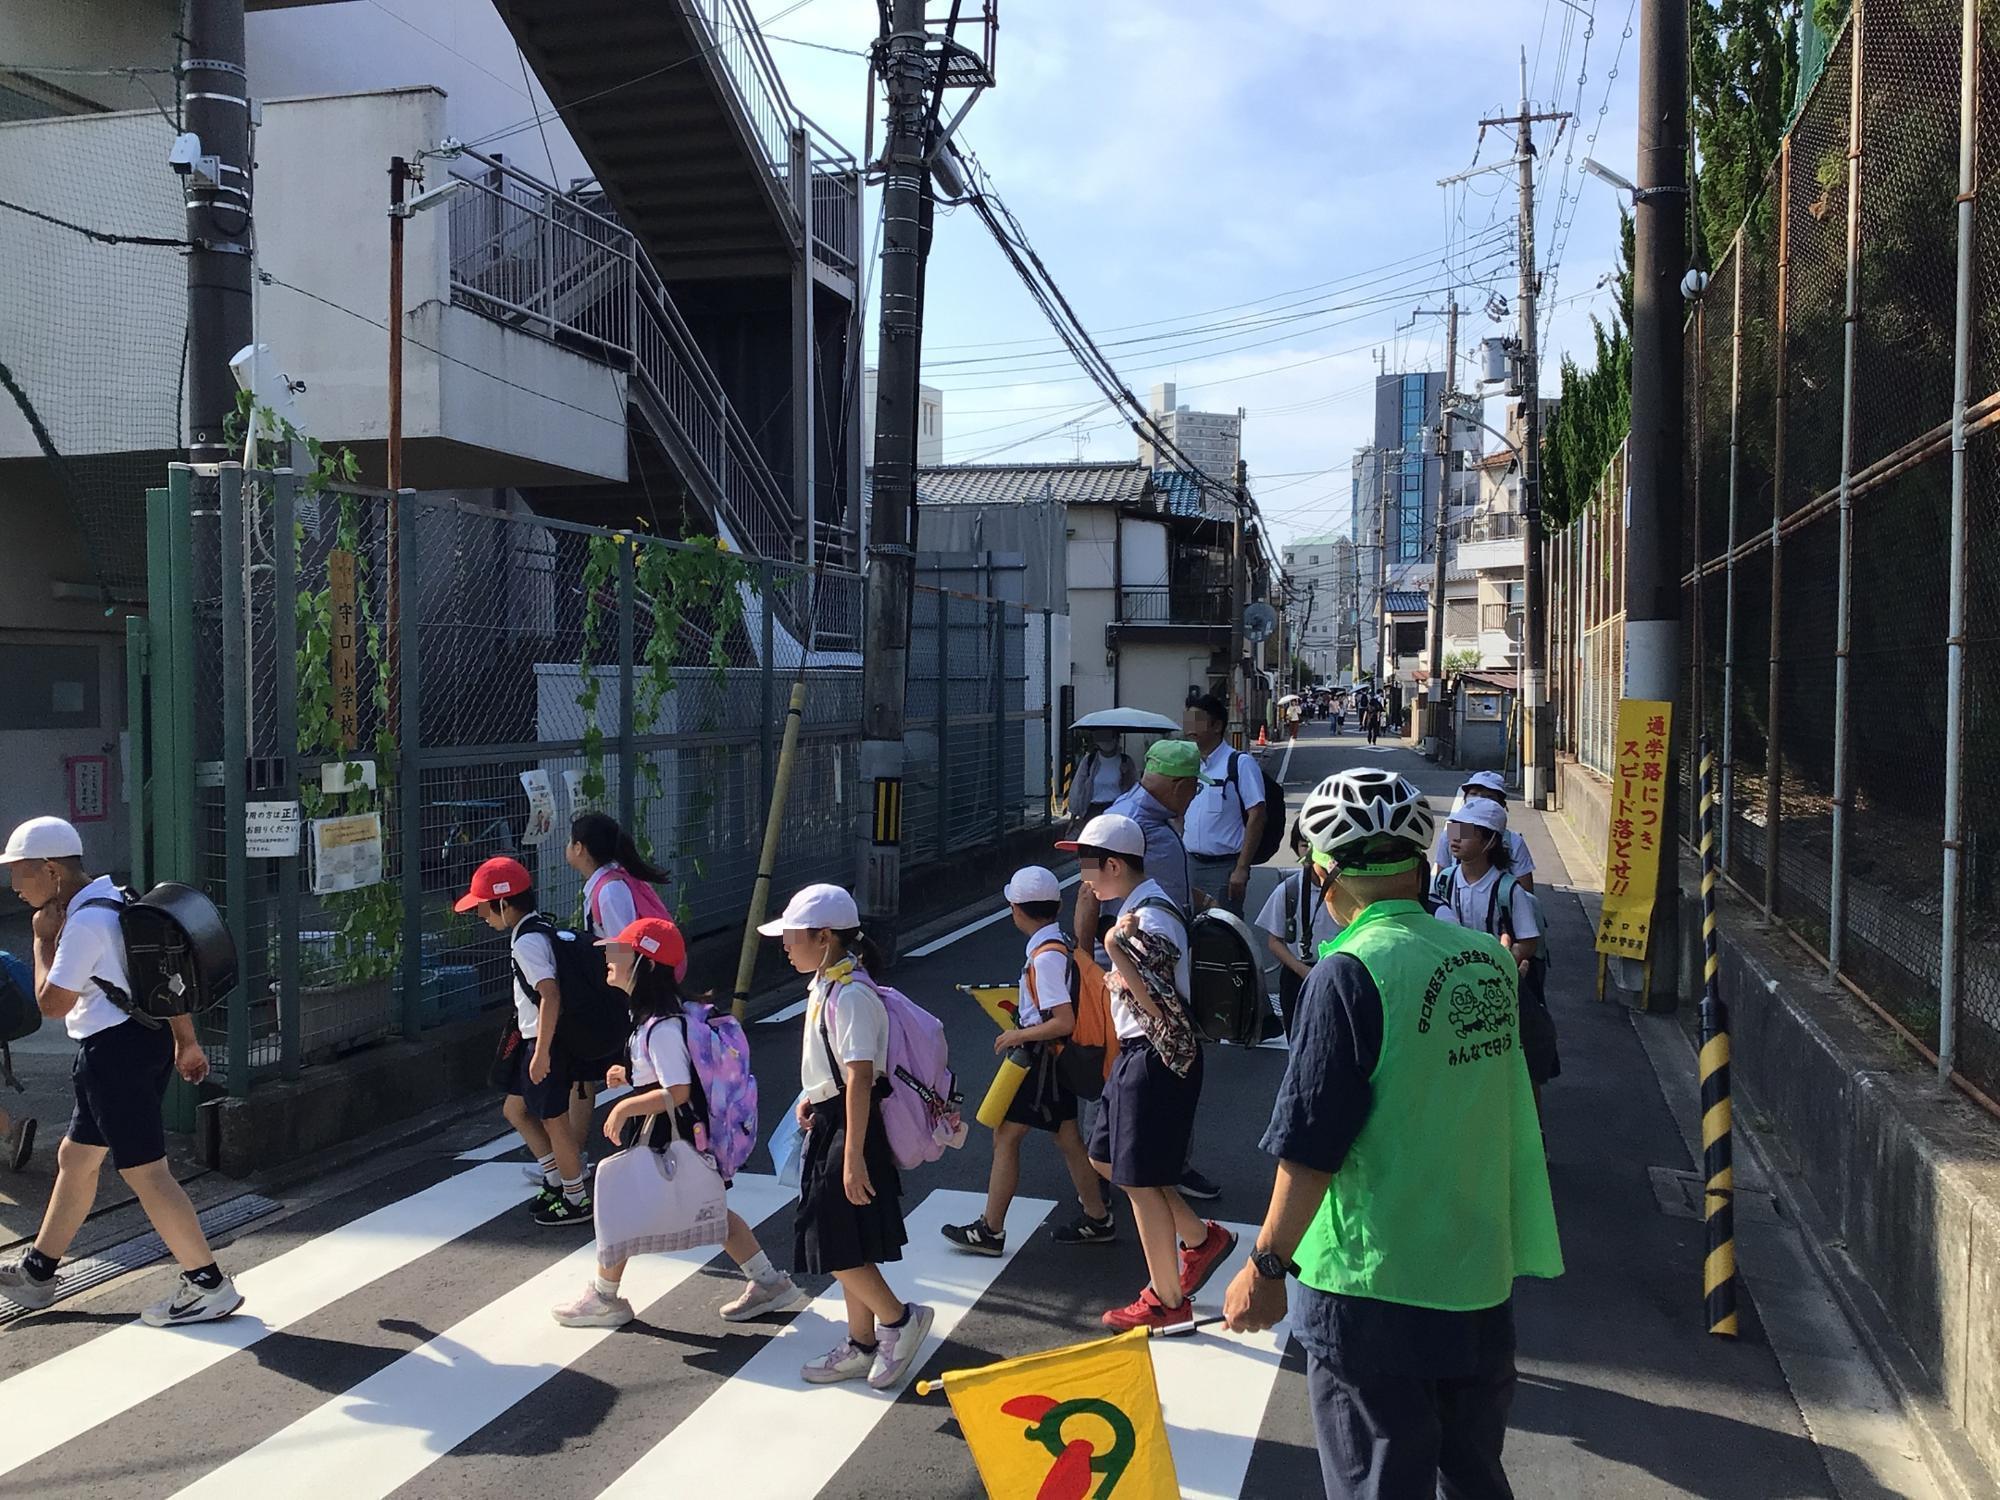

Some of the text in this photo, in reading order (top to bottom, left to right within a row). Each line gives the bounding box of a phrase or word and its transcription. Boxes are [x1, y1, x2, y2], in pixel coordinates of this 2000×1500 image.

[339, 602, 355, 736] 守口小学校
[1609, 741, 1640, 896] スピード落とせ!!
[1641, 715, 1667, 850] 通学路につき
